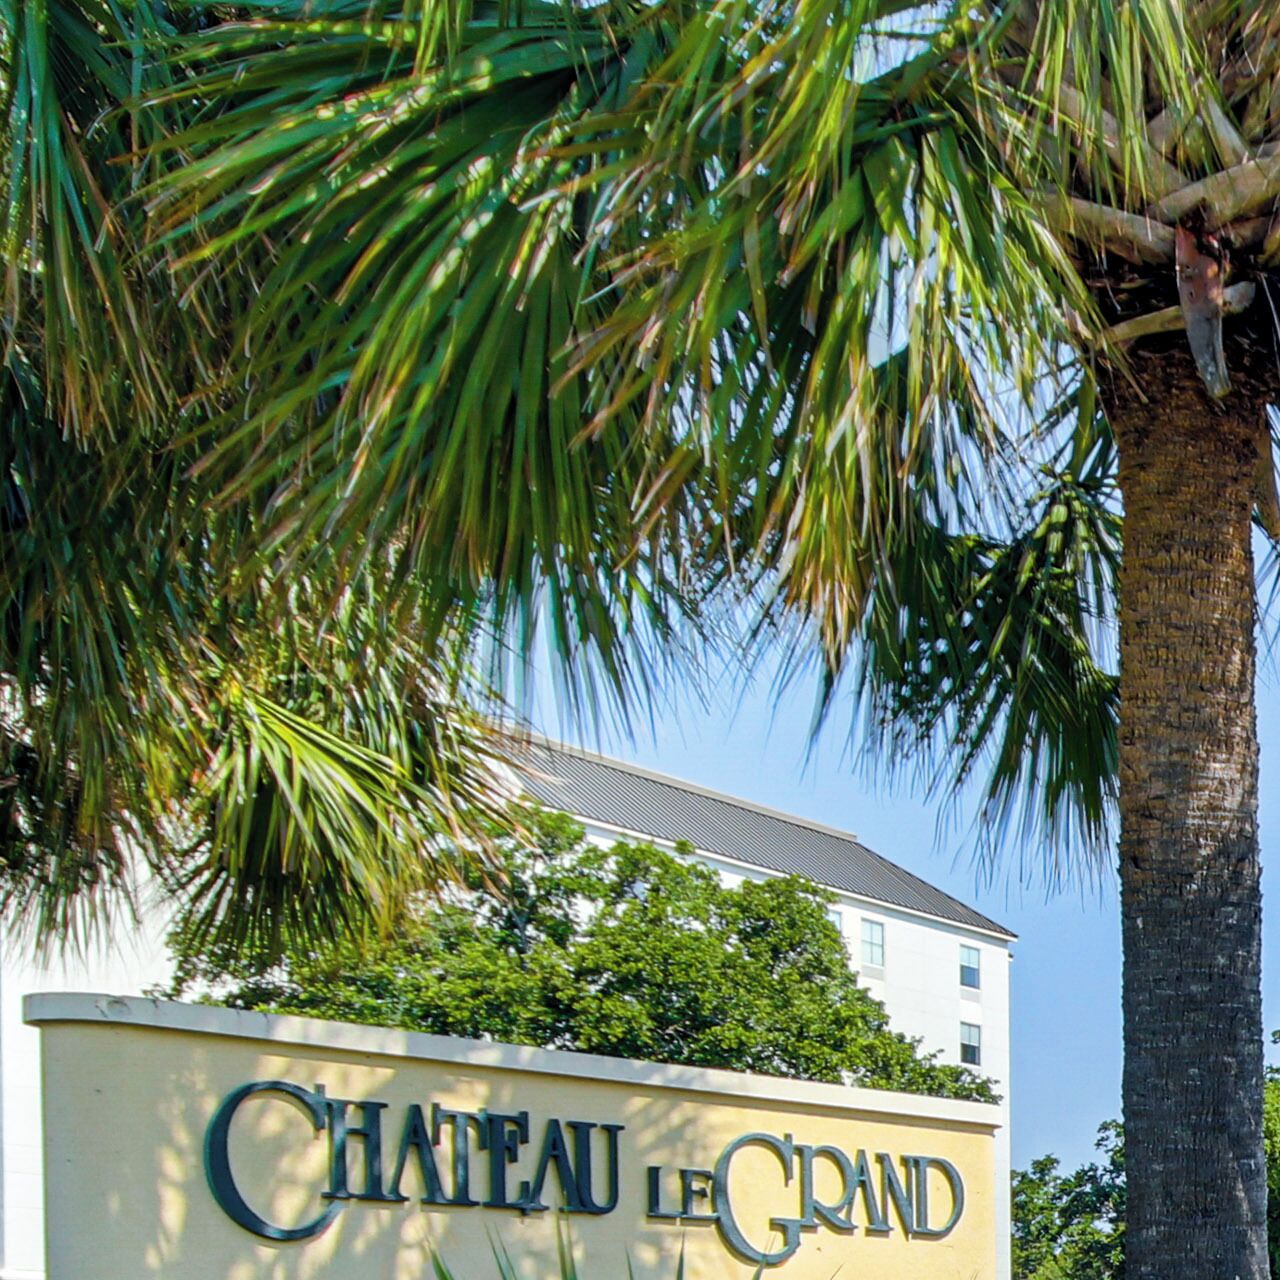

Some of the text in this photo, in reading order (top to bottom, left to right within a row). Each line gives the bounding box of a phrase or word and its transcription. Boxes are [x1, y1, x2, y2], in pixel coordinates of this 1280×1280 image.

[203, 1080, 965, 1267] CHATEAU LE GRAND
